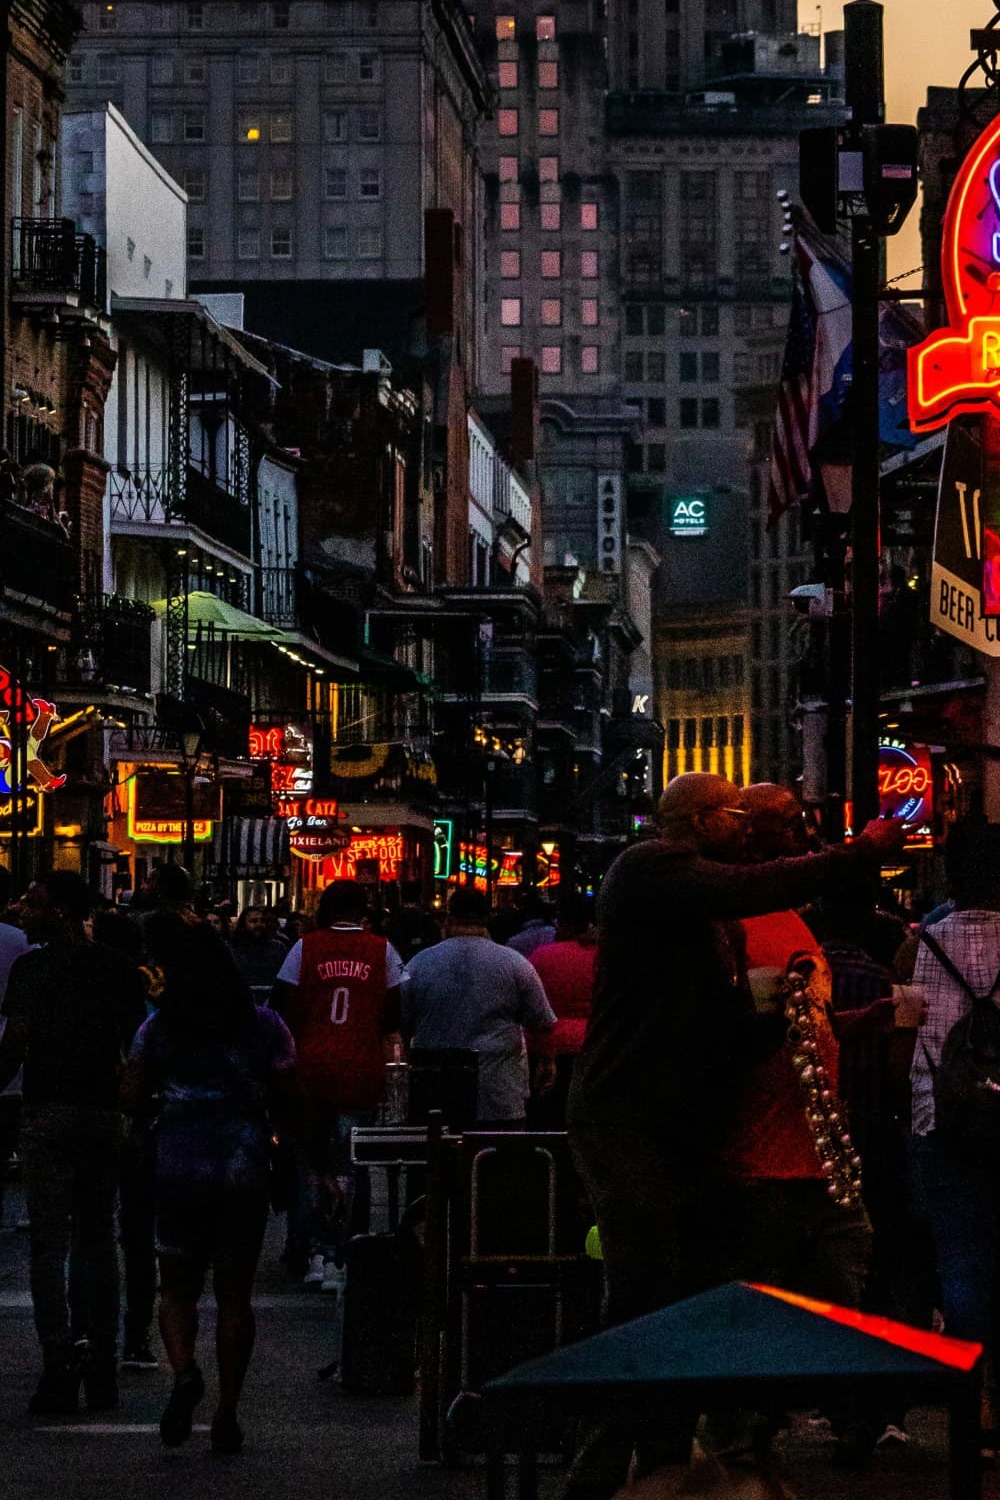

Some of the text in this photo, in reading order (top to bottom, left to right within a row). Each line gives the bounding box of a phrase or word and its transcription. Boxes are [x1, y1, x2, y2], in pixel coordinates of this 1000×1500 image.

[673, 500, 705, 518] AC
[939, 579, 976, 634] BEER
[136, 822, 157, 832] PIZZA
[317, 960, 372, 980] COUSINS
